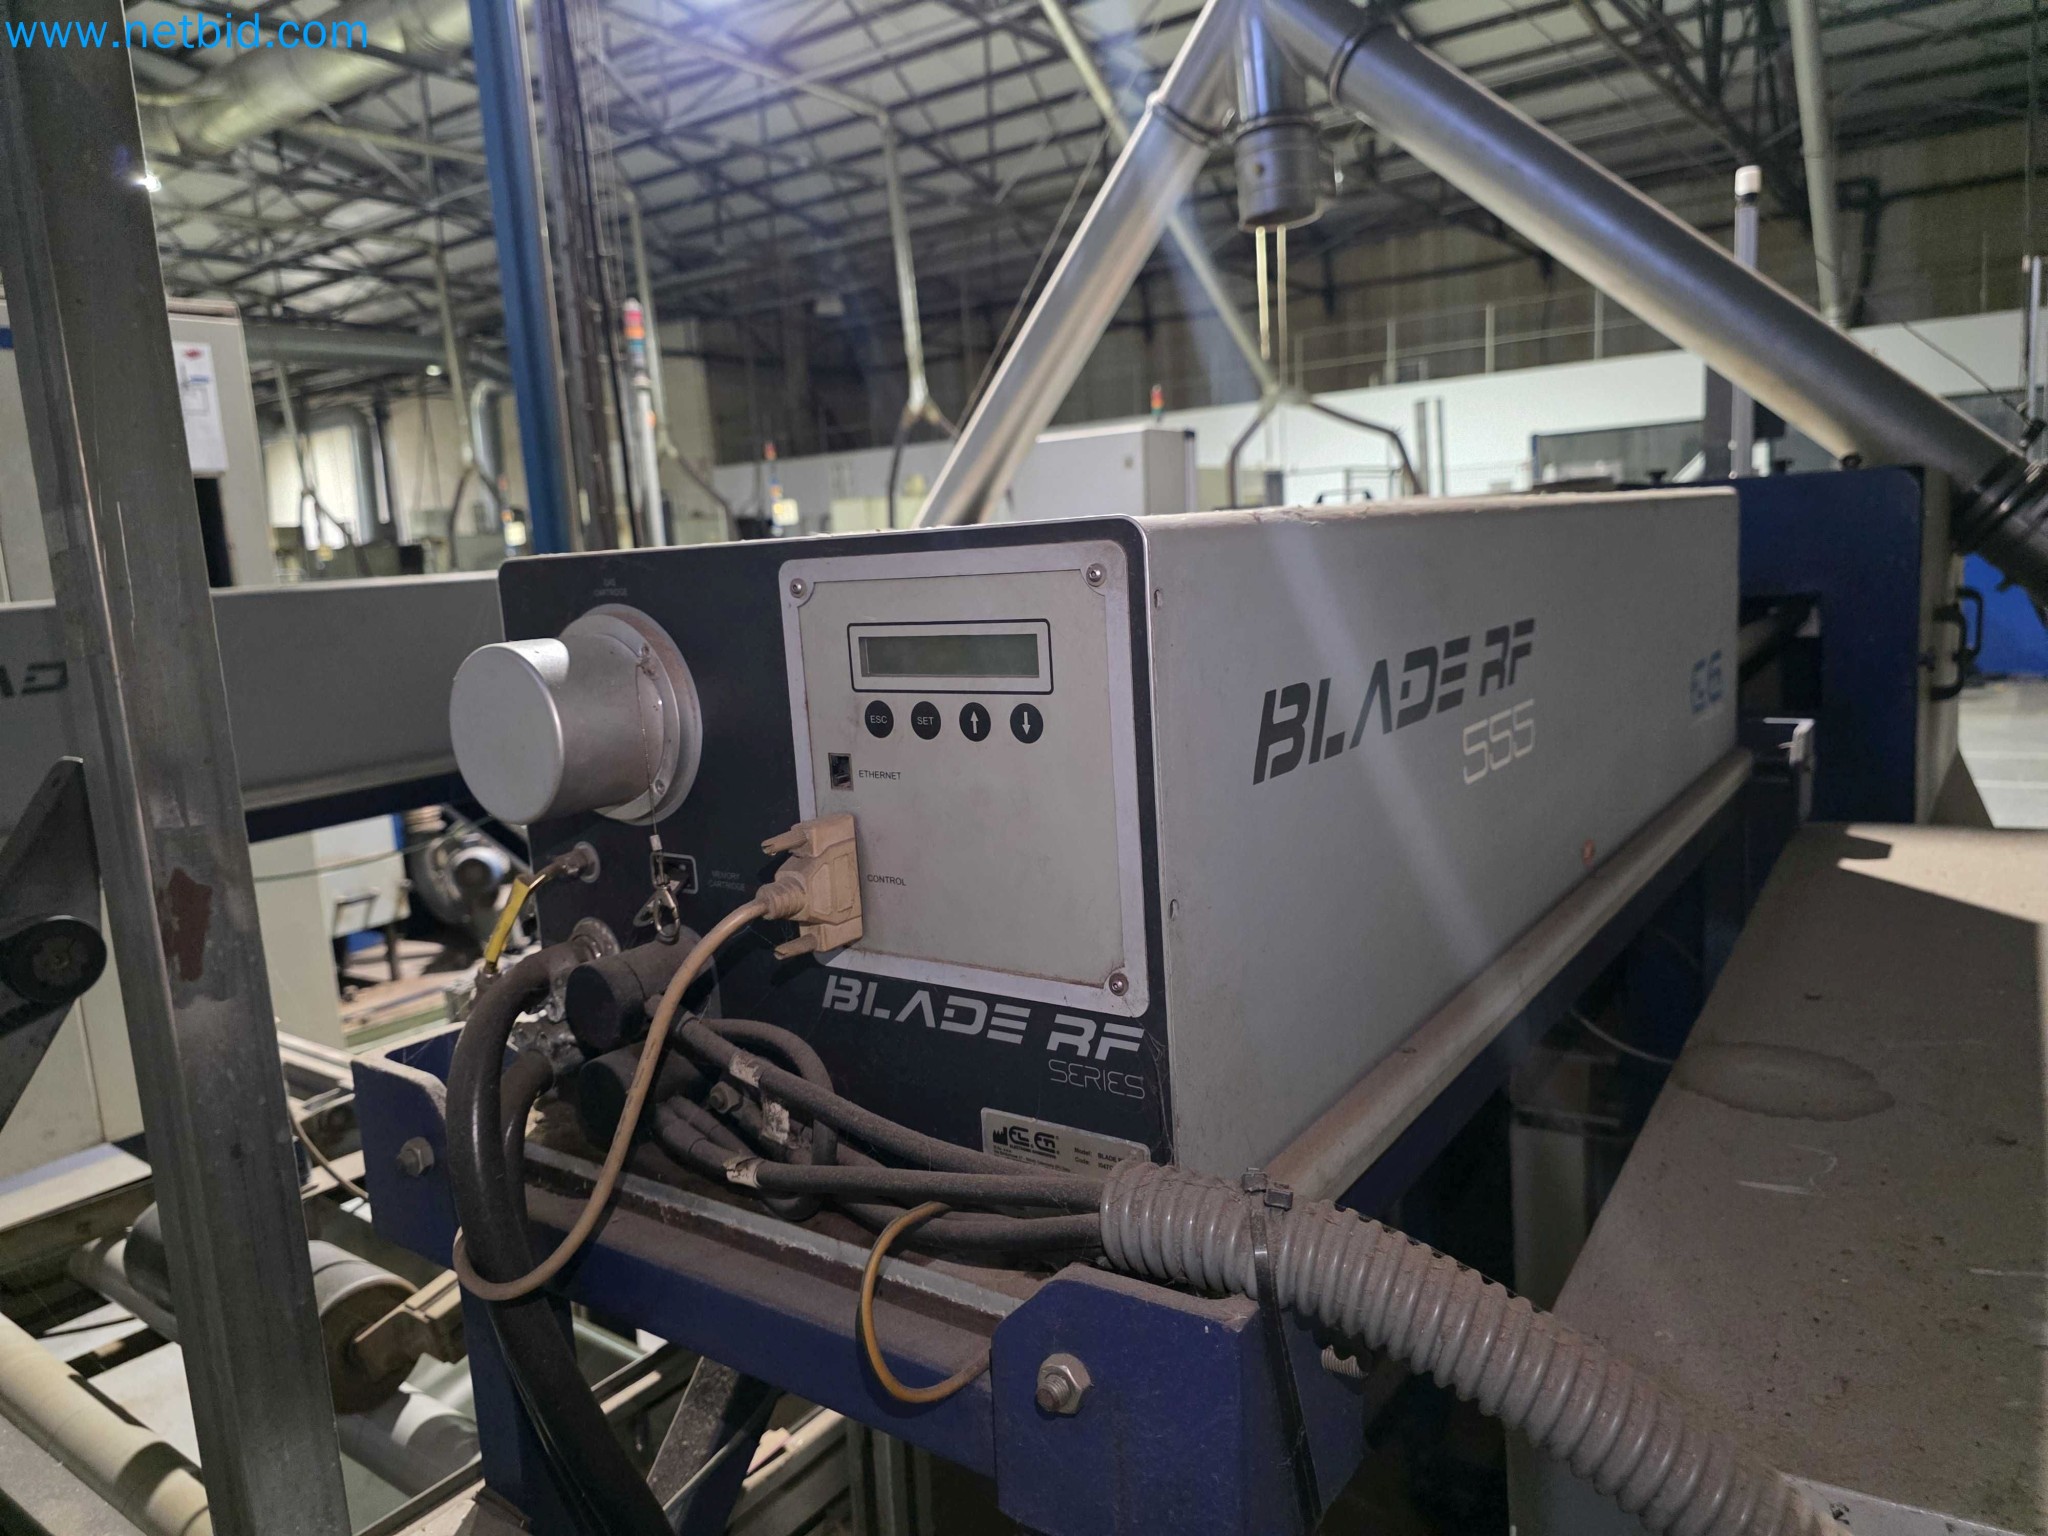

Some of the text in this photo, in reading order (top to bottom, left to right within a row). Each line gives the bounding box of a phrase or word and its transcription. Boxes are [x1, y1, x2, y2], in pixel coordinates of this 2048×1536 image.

[1253, 618, 1536, 786] BLADE RF
[870, 715, 888, 725] ESC
[916, 716, 934, 726] SET
[858, 769, 902, 781] ETHERNET
[867, 874, 907, 887] CONTROL
[821, 974, 1145, 1061] BLADE RF
[1048, 1059, 1146, 1100] SERIES
